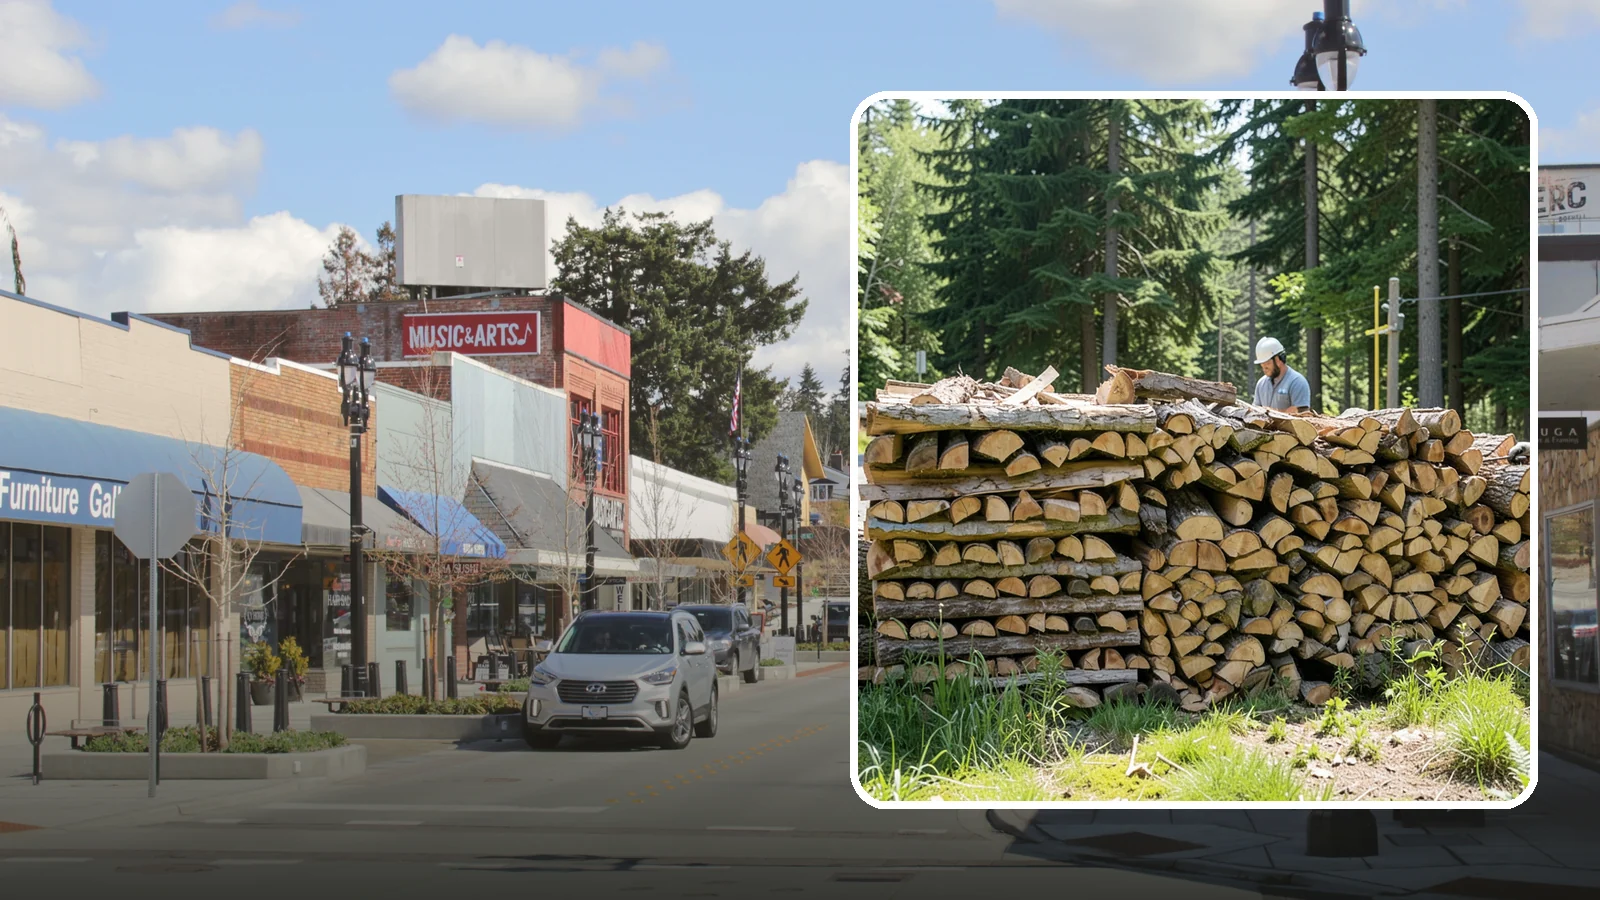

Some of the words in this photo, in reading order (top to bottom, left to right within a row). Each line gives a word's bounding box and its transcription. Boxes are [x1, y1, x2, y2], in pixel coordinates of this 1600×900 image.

[409, 323, 520, 349] MUSIC&ARTS
[0, 471, 80, 516] Furniture
[89, 482, 121, 520] Gal
[454, 563, 480, 575] SUSHI
